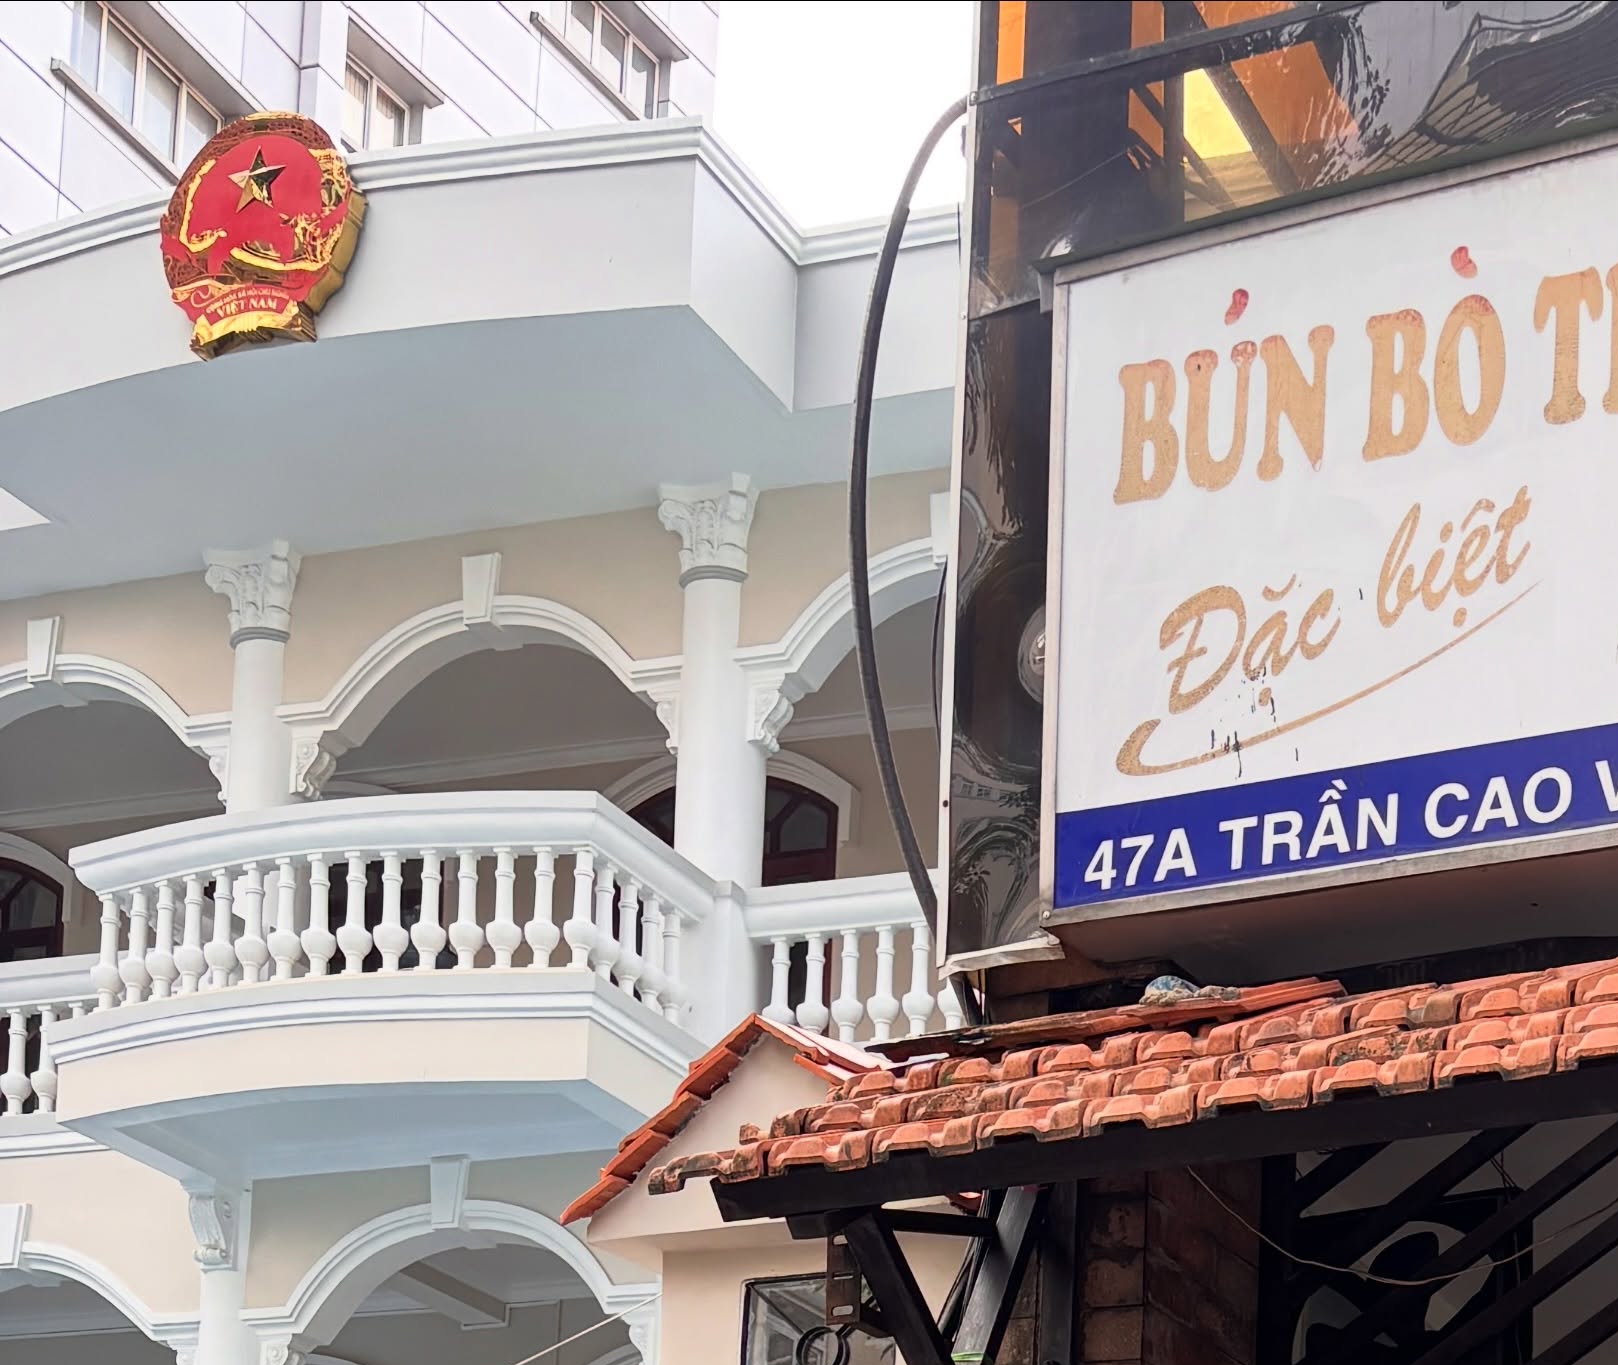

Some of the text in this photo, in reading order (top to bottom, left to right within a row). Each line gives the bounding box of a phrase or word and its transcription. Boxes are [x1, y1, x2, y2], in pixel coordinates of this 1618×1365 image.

[248, 297, 278, 310] NAM
[1112, 287, 1335, 505] BÚN
[1361, 245, 1506, 461] BÒ
[1158, 484, 1533, 716] Đặc biệt
[1083, 827, 1198, 892] 47A
[1218, 778, 1400, 871] TRẦN
[1423, 765, 1573, 840] CAO
